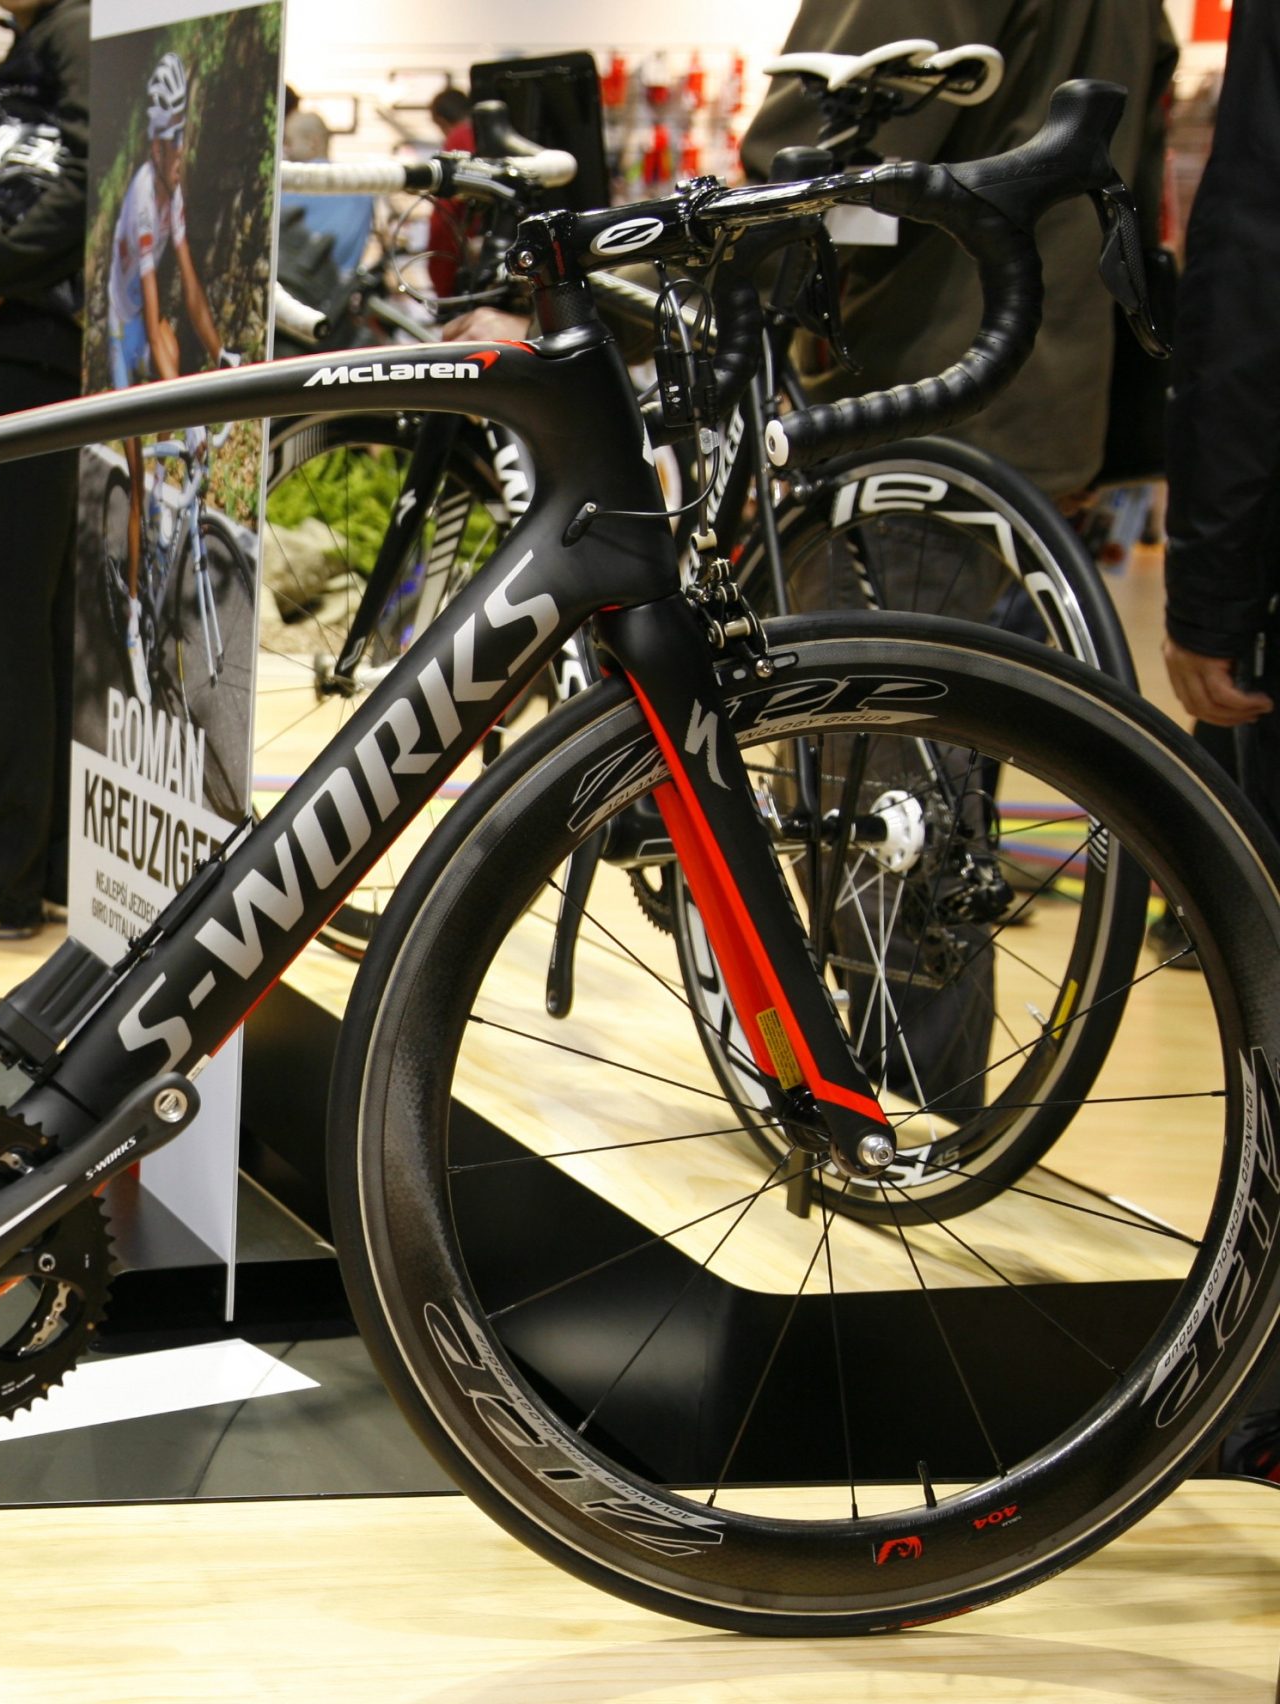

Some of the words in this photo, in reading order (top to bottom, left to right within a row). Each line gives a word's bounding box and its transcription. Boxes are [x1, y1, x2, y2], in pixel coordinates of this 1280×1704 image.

[303, 362, 480, 388] McLaren
[107, 686, 206, 809] ROMAN
[117, 549, 560, 1076] S-WORKS
[91, 897, 108, 924] GIRO
[85, 1135, 138, 1181] S-WORKS
[972, 1504, 1019, 1530] 404
